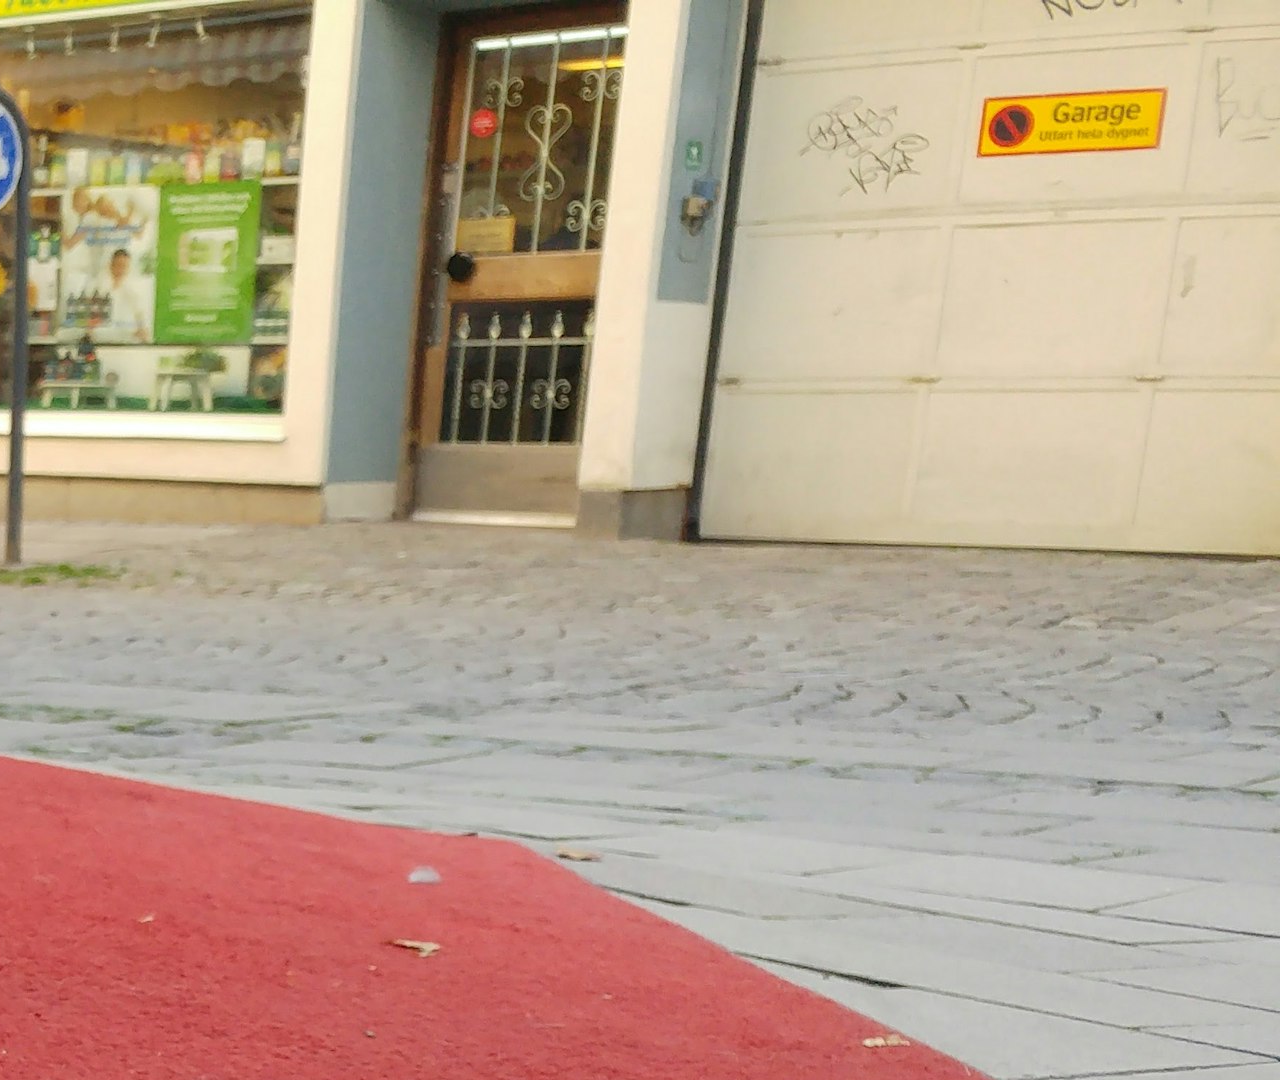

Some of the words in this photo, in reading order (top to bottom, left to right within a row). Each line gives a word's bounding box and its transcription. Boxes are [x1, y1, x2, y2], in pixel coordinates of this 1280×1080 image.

[1053, 102, 1141, 126] Garage
[1039, 130, 1073, 141] Utfart
[1077, 128, 1103, 139] hela
[1107, 127, 1149, 139] dygnet
